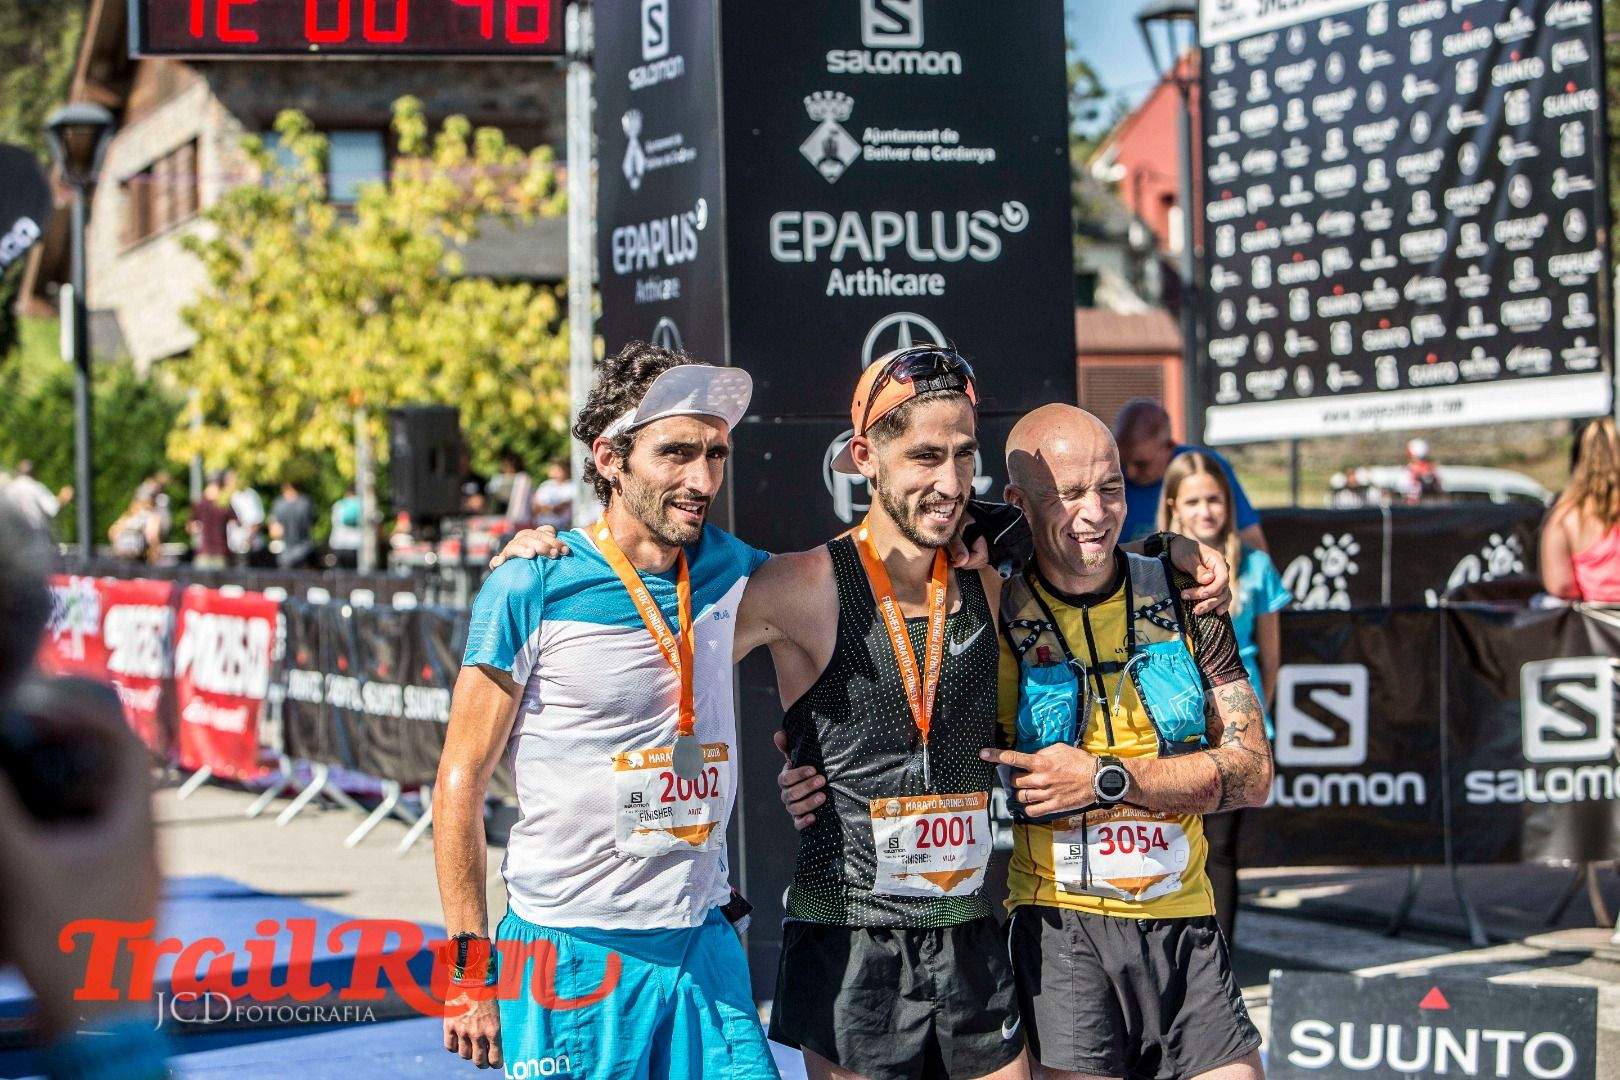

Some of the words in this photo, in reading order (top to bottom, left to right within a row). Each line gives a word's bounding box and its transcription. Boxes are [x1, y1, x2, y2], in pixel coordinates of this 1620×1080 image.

[826, 50, 962, 75] salomon
[612, 210, 699, 275] EPAPLUS
[769, 209, 1002, 263] EPAPLUS
[826, 266, 946, 296] Arthicare
[931, 609, 943, 643] PIRINEU
[881, 595, 901, 633] FINISHER
[895, 633, 912, 668] MARATÓ
[905, 668, 918, 701] PIRINEU
[929, 644, 941, 680] MARATÓ
[926, 679, 937, 718] FINISHER
[659, 766, 719, 802] 2002
[640, 806, 674, 822] FINISHER
[905, 799, 937, 811] MARATÓ
[915, 815, 976, 849] 2001
[1097, 825, 1169, 855] 3054
[1287, 1019, 1578, 1080] SUUNTO
